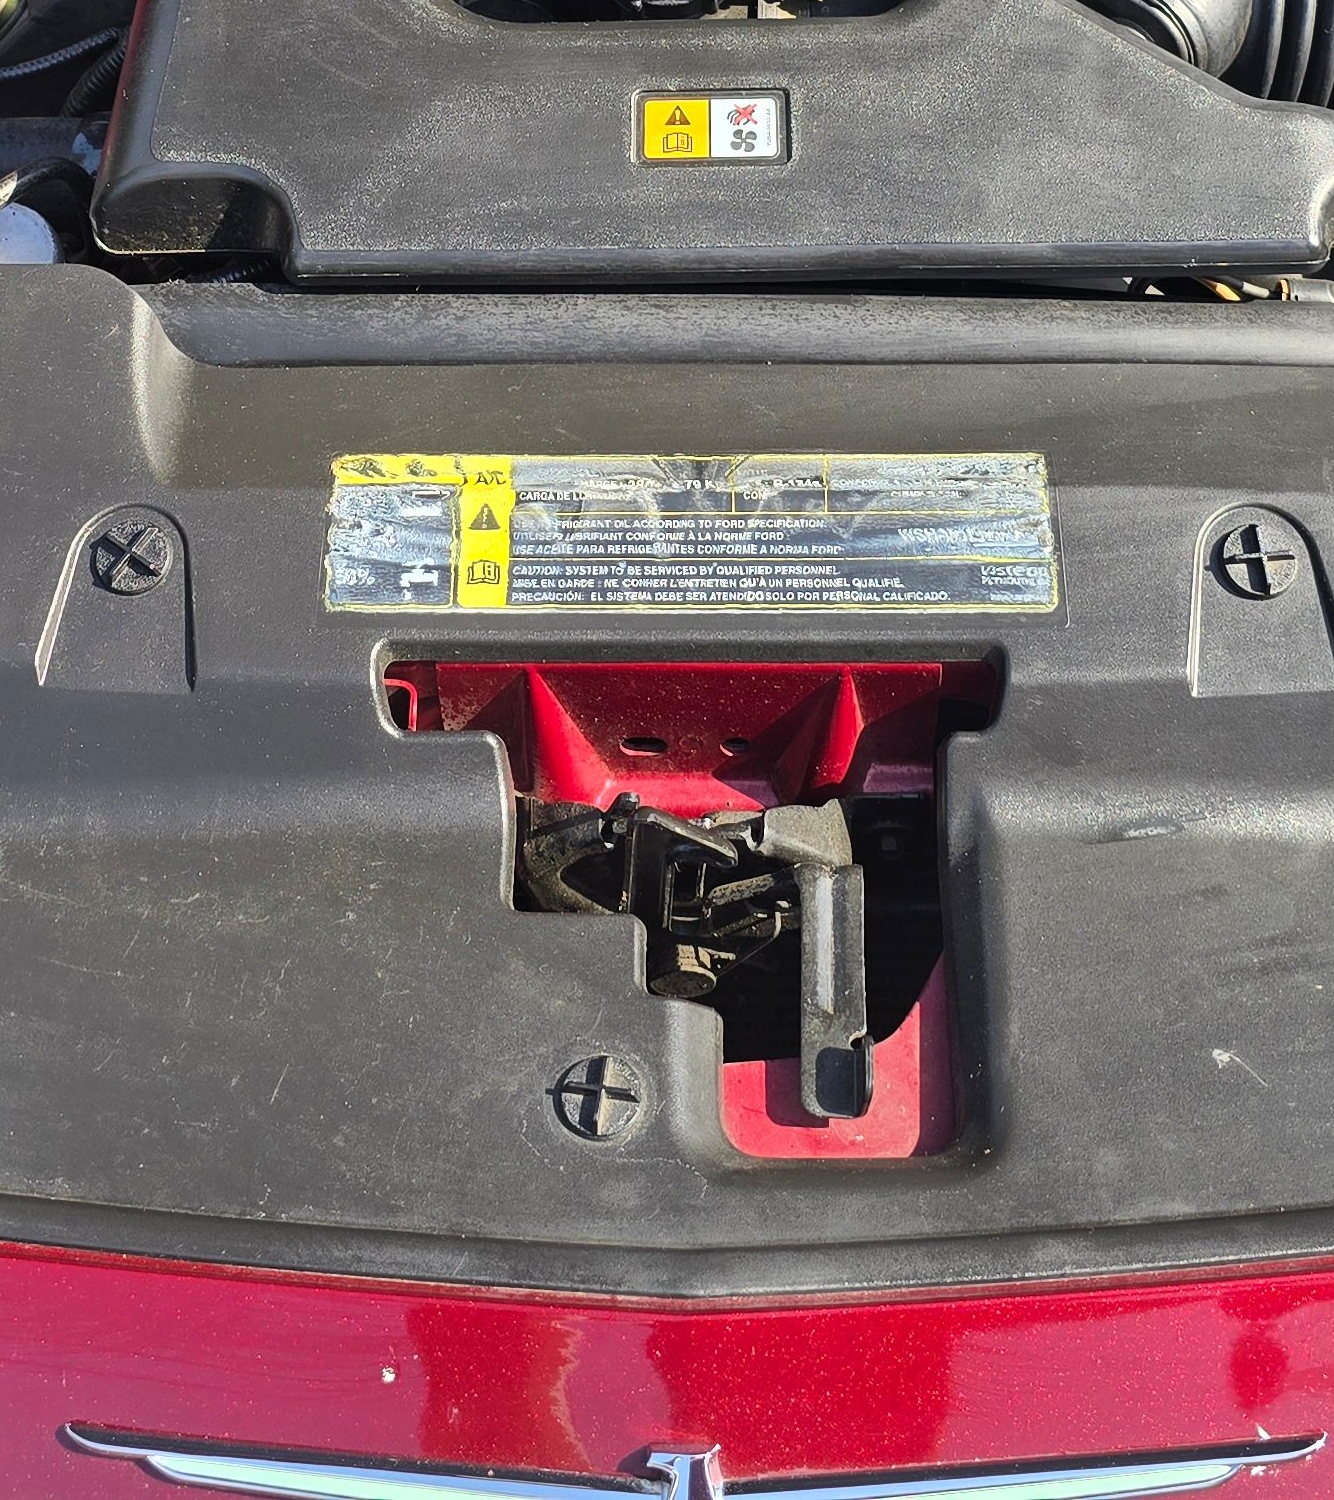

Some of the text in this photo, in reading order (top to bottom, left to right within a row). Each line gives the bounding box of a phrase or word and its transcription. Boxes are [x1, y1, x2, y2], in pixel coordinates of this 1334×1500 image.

[537, 520, 612, 529] FRIGERANT
[614, 520, 631, 529] OIL
[632, 520, 695, 529] ACCORDING
[698, 520, 712, 529] TO
[715, 520, 745, 529] FORD
[697, 532, 712, 541] LA
[714, 532, 752, 541] NORME
[576, 544, 605, 554] PARA
[607, 543, 695, 554] REFRIGERANTES
[697, 544, 758, 554] CONFORME
[760, 544, 768, 554] A
[770, 544, 809, 554] NORMA
[513, 566, 563, 575] CAUTION:
[565, 566, 609, 575] SYSTEM
[611, 566, 624, 576] TO
[627, 566, 641, 575] BE
[644, 566, 697, 575] SERVICED
[699, 566, 714, 575] BY
[717, 566, 773, 575] QUALIFIED
[541, 579, 557, 588] EN
[558, 579, 595, 588] GARDE
[604, 579, 620, 588] NE
[769, 579, 783, 588] UN
[785, 578, 850, 588] PERSONNEL
[591, 592, 603, 601] EL
[607, 592, 652, 601] SISTEMA
[655, 592, 684, 601] DEBE
[686, 592, 708, 601] SER
[710, 591, 765, 602] ATENDIDO
[766, 592, 795, 601] SOLO
[797, 592, 820, 601] POR
[823, 592, 880, 601] PERSONAL
[883, 592, 951, 601] CALIFICADO.
